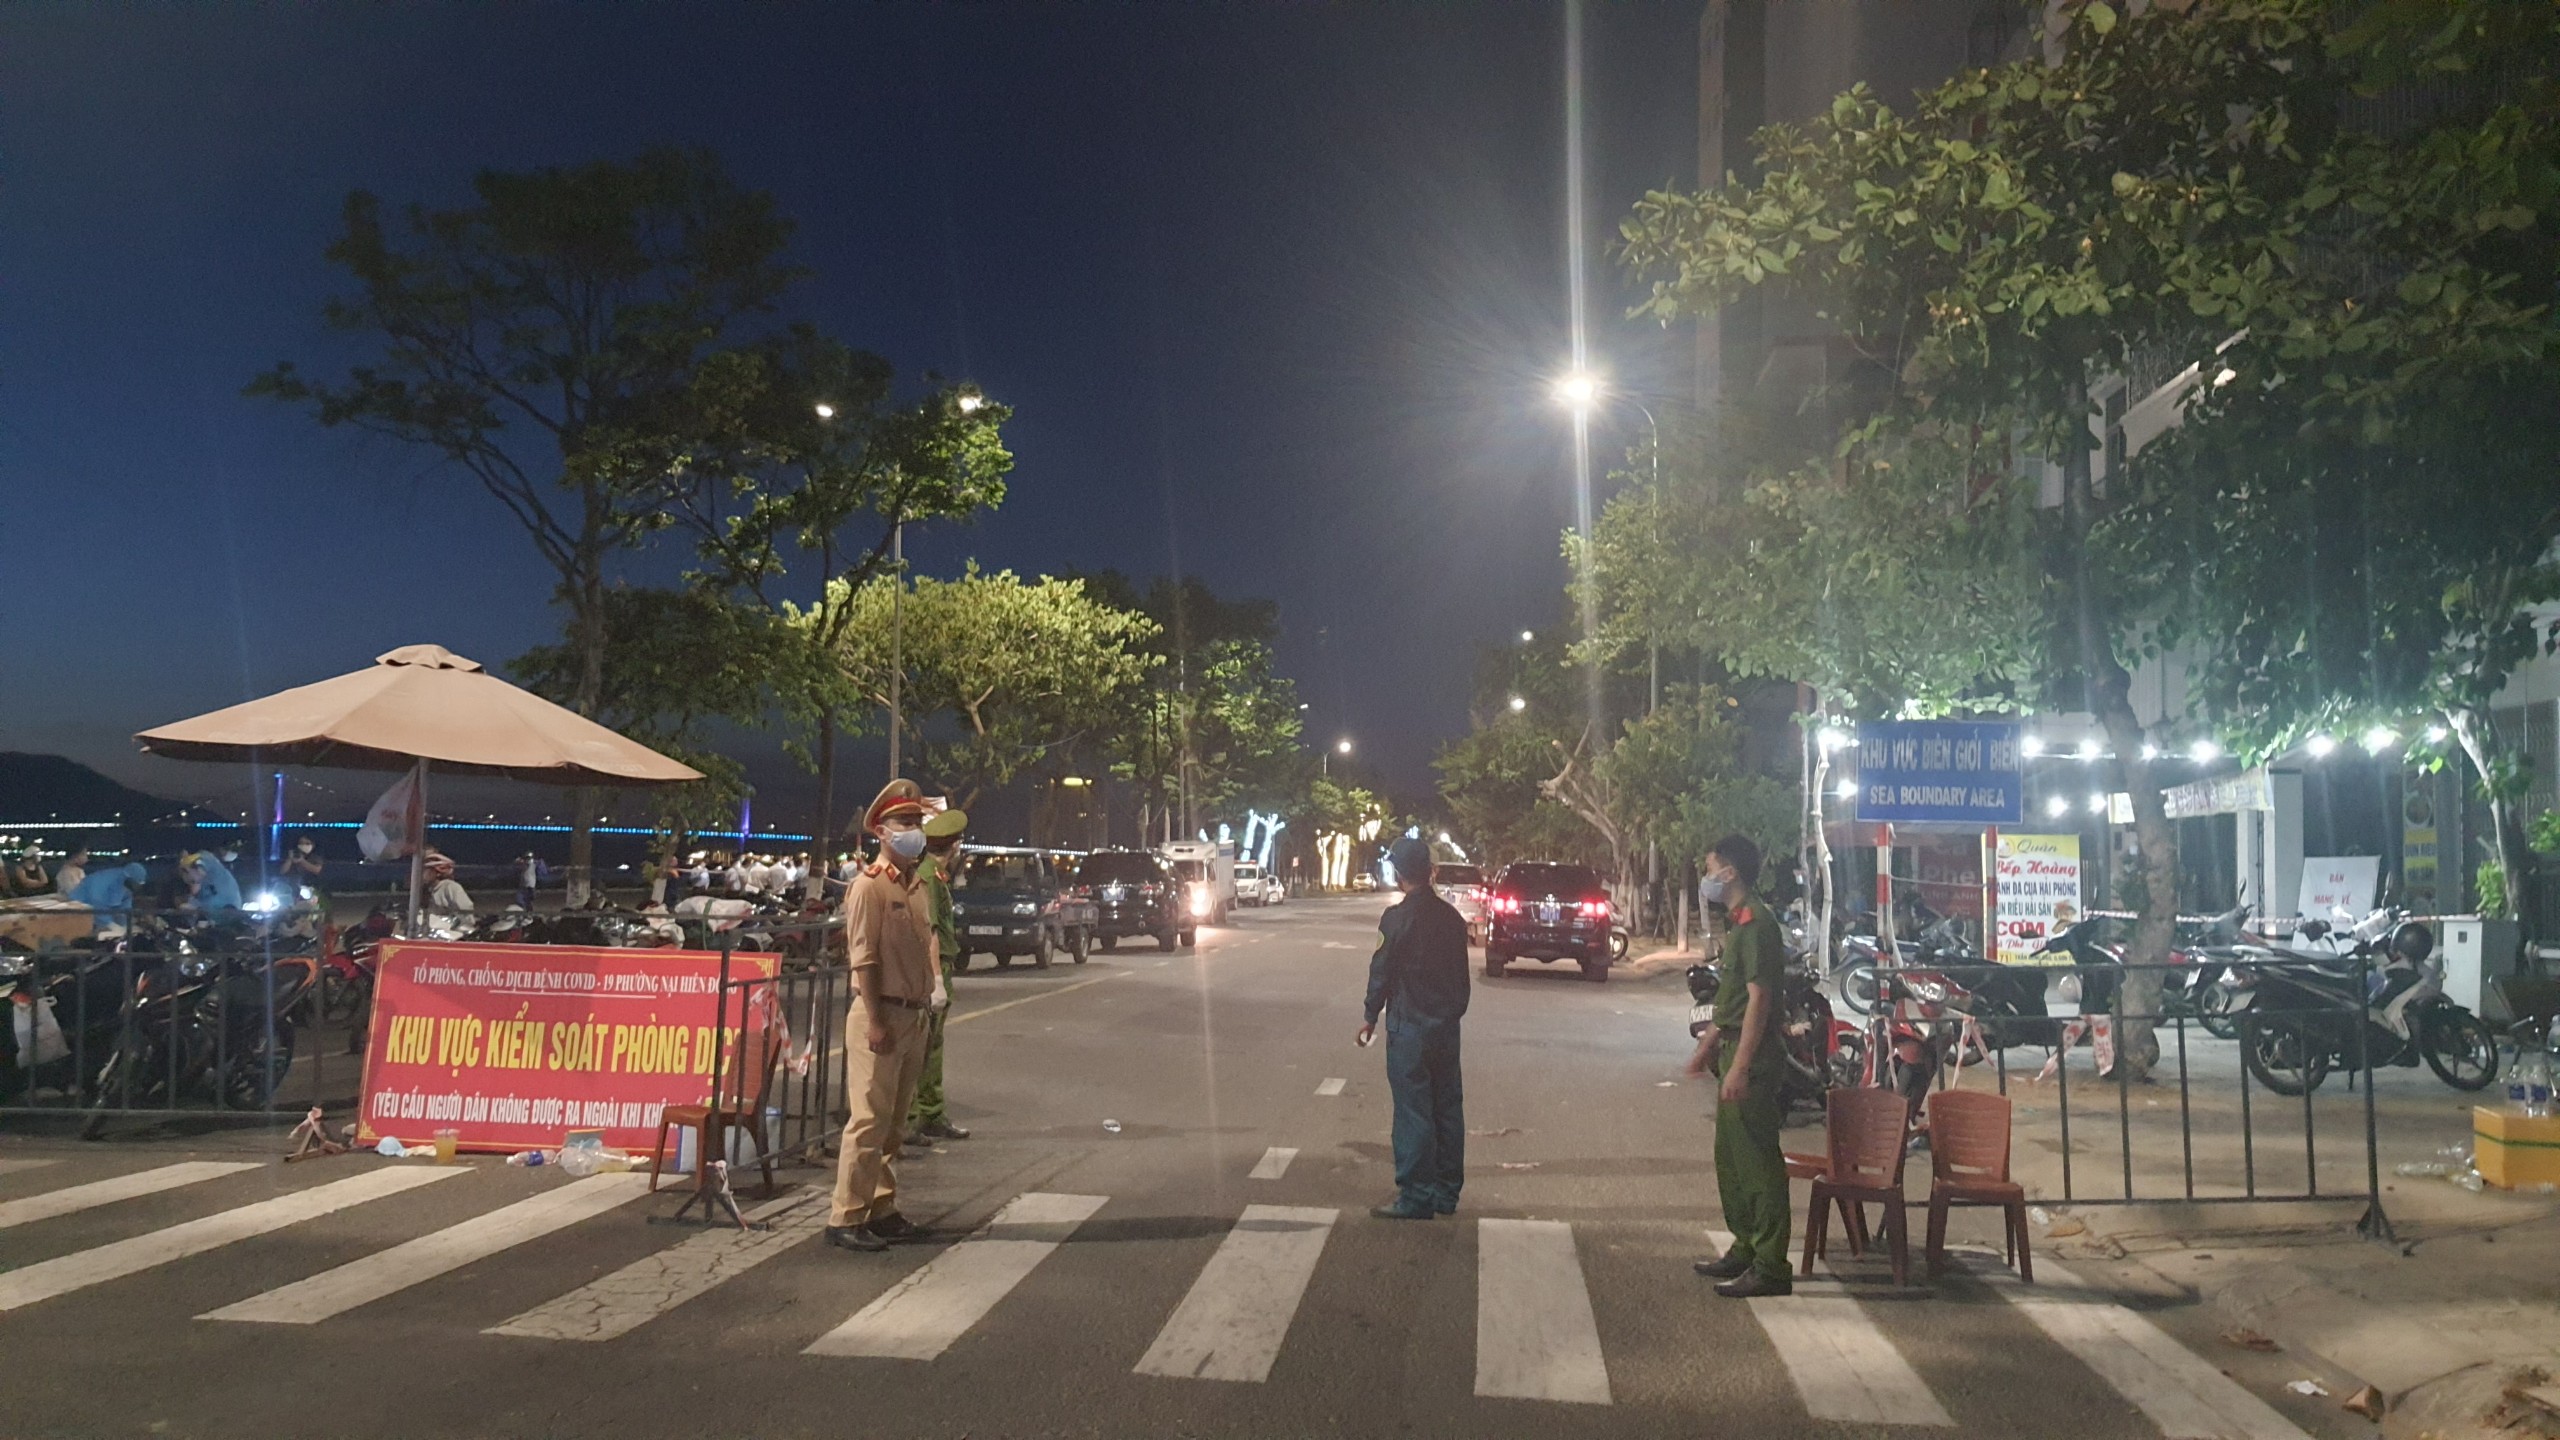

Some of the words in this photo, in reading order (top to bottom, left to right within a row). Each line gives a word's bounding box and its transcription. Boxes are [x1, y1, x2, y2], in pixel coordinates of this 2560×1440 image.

[1860, 738, 1888, 769] KHU
[1892, 733, 1918, 772] VỰC
[1922, 732, 1951, 771] BIÊN
[1955, 727, 1982, 771] GIỚI
[1990, 726, 2020, 771] BIỂN
[1870, 785, 1896, 805] SEA
[1900, 786, 1967, 806] BOUNDARY
[1969, 788, 2005, 808] AREA
[2027, 860, 2077, 878] Hoàng
[1997, 919, 2045, 938] CƠM
[468, 961, 505, 987] CHỐNG
[505, 969, 533, 991] DỊCH
[533, 968, 562, 992] BỆNH
[563, 972, 596, 990] COVID
[603, 974, 614, 991] 19
[615, 970, 659, 992] PHƯỜNG
[660, 975, 679, 998] NẠI
[386, 1015, 435, 1065] KHU
[438, 1013, 483, 1078] VỰC
[485, 1000, 546, 1070] KIỂM
[548, 1013, 609, 1073] SOÁT
[610, 1013, 690, 1075] PHÒNG
[693, 1026, 742, 1087] DỊC
[372, 1087, 400, 1119] (YÊU
[426, 1089, 463, 1121] NGƯỜI
[463, 1091, 489, 1123] DÂN
[489, 1093, 530, 1124] KHÔNG
[531, 1097, 563, 1131] ĐƯỢC
[564, 1100, 581, 1126] RA
[582, 1096, 619, 1128] NGOÀI
[620, 1102, 642, 1128] KHI
